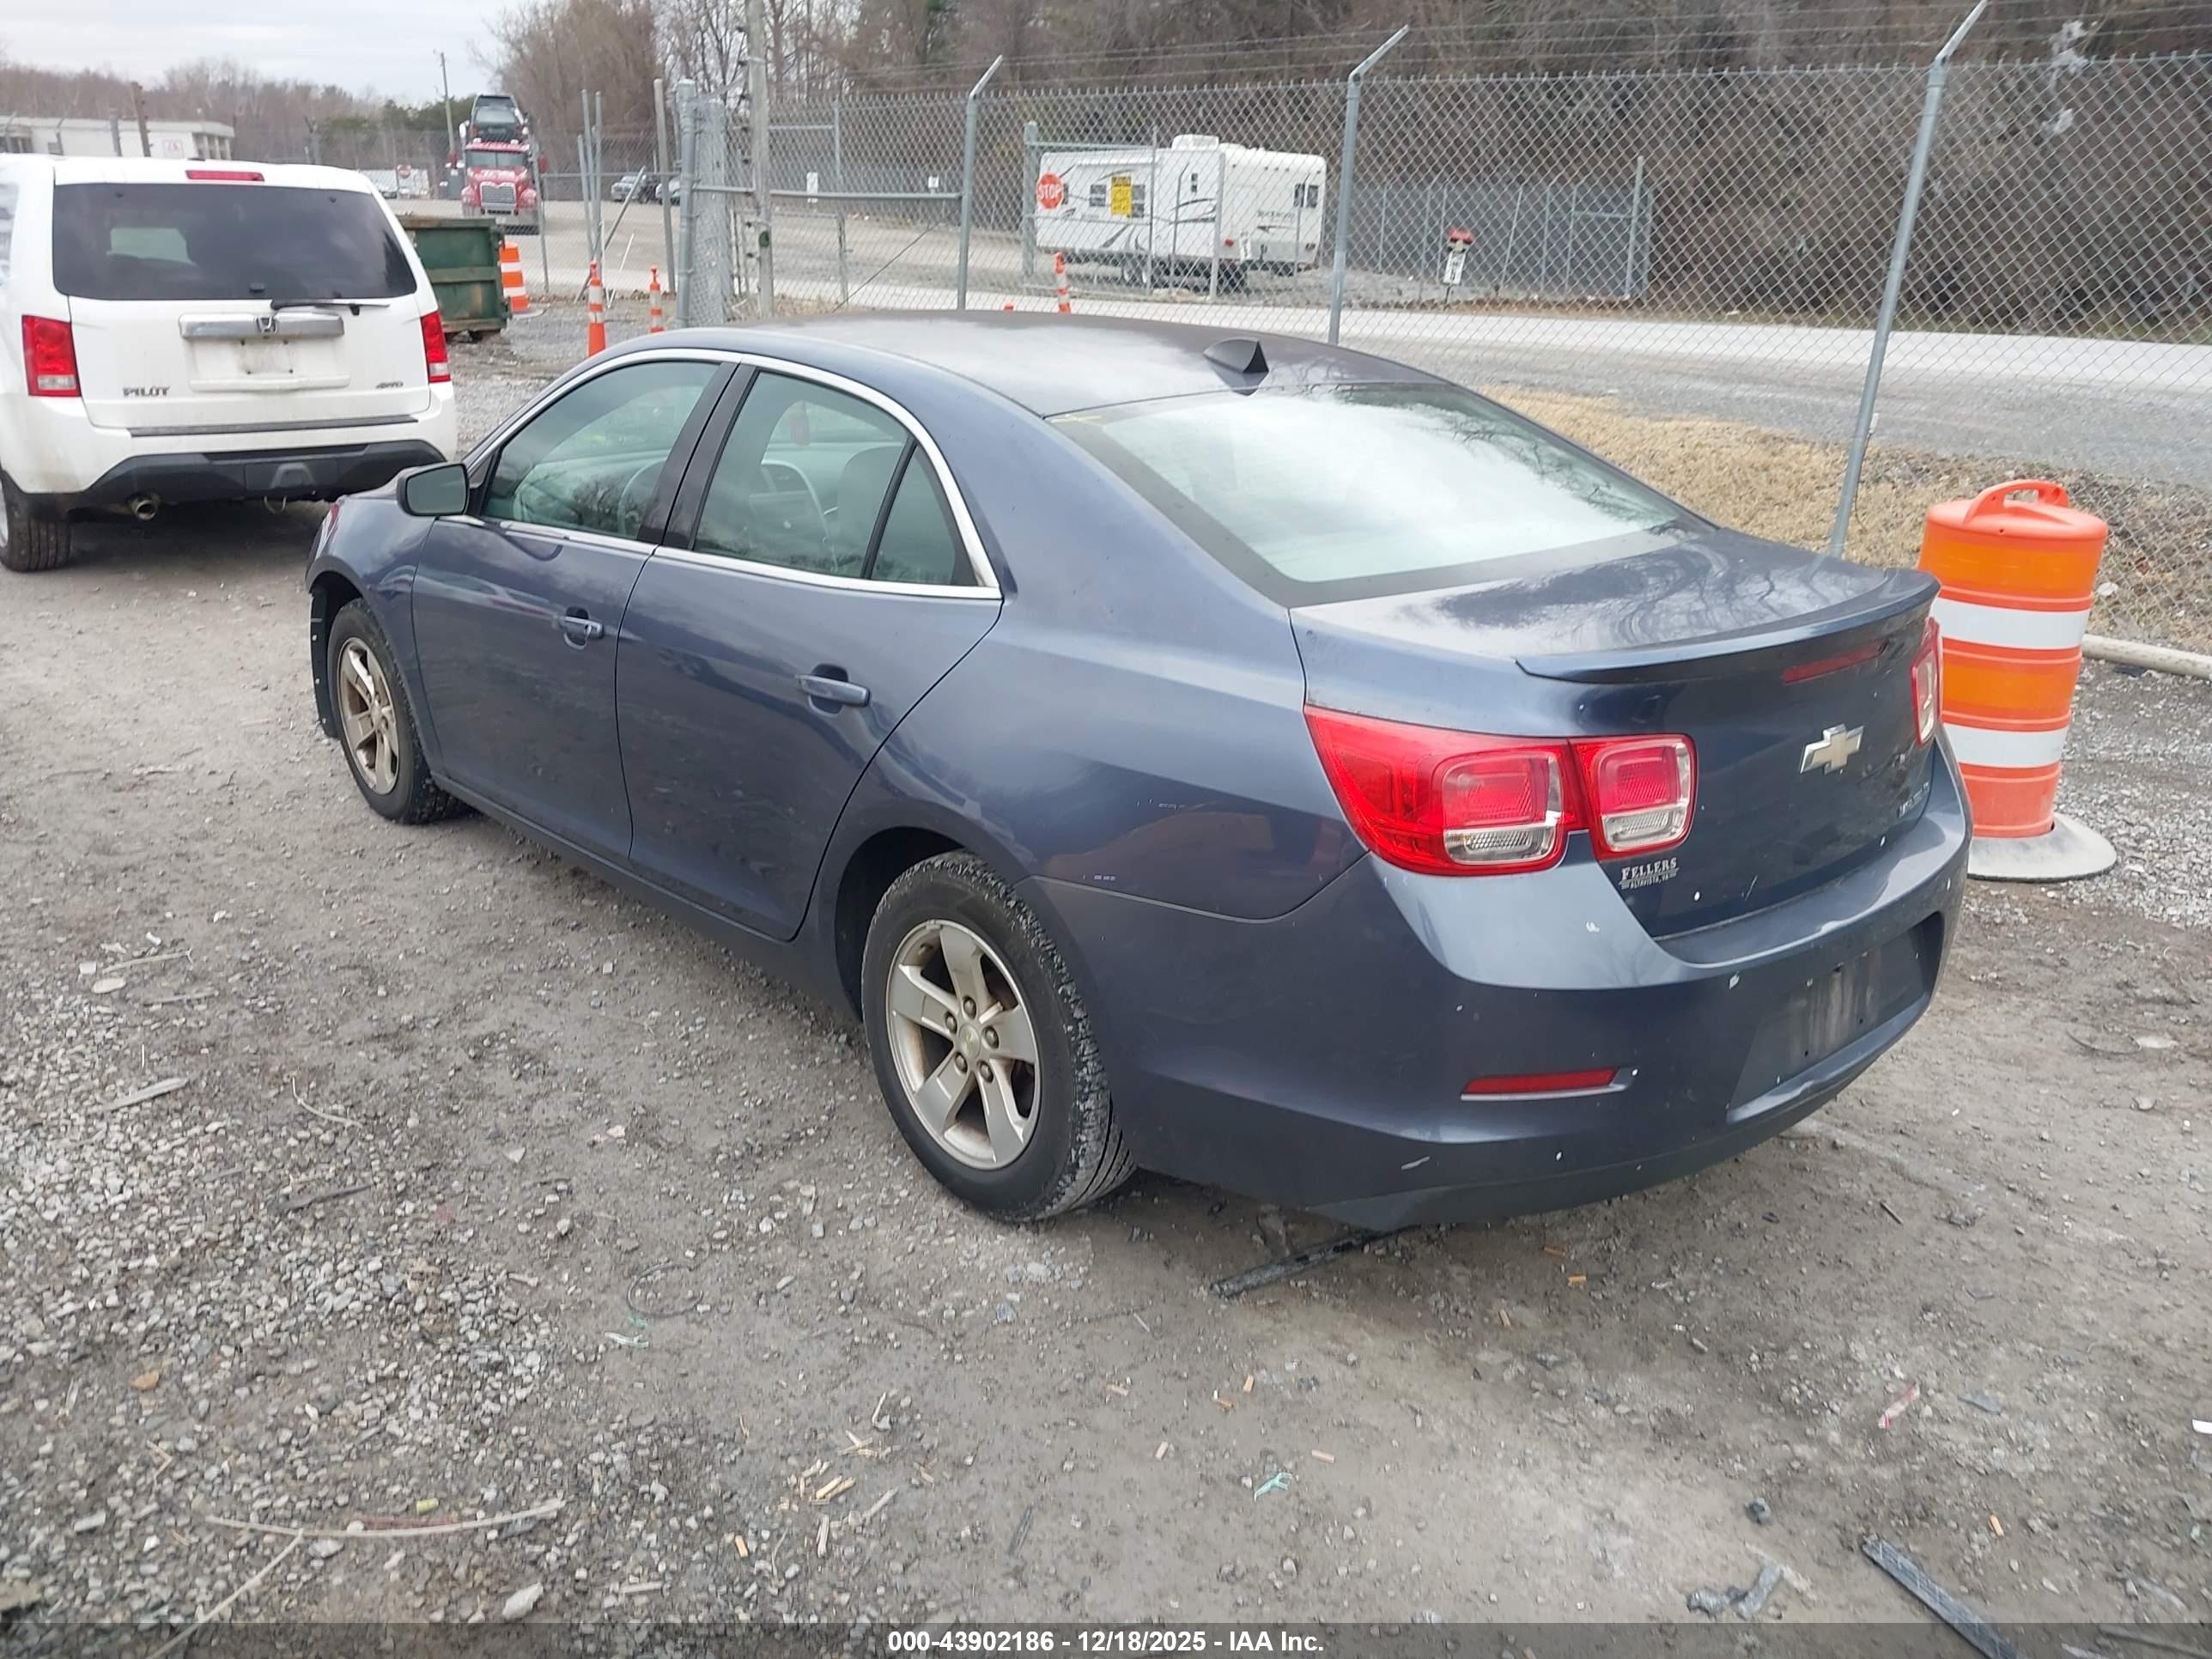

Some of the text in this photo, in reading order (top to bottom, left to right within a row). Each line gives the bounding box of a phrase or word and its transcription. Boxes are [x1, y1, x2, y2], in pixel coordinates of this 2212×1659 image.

[1037, 184, 1062, 200] STOP
[122, 386, 170, 398] PILOT
[1620, 857, 1677, 880] FELLERS
